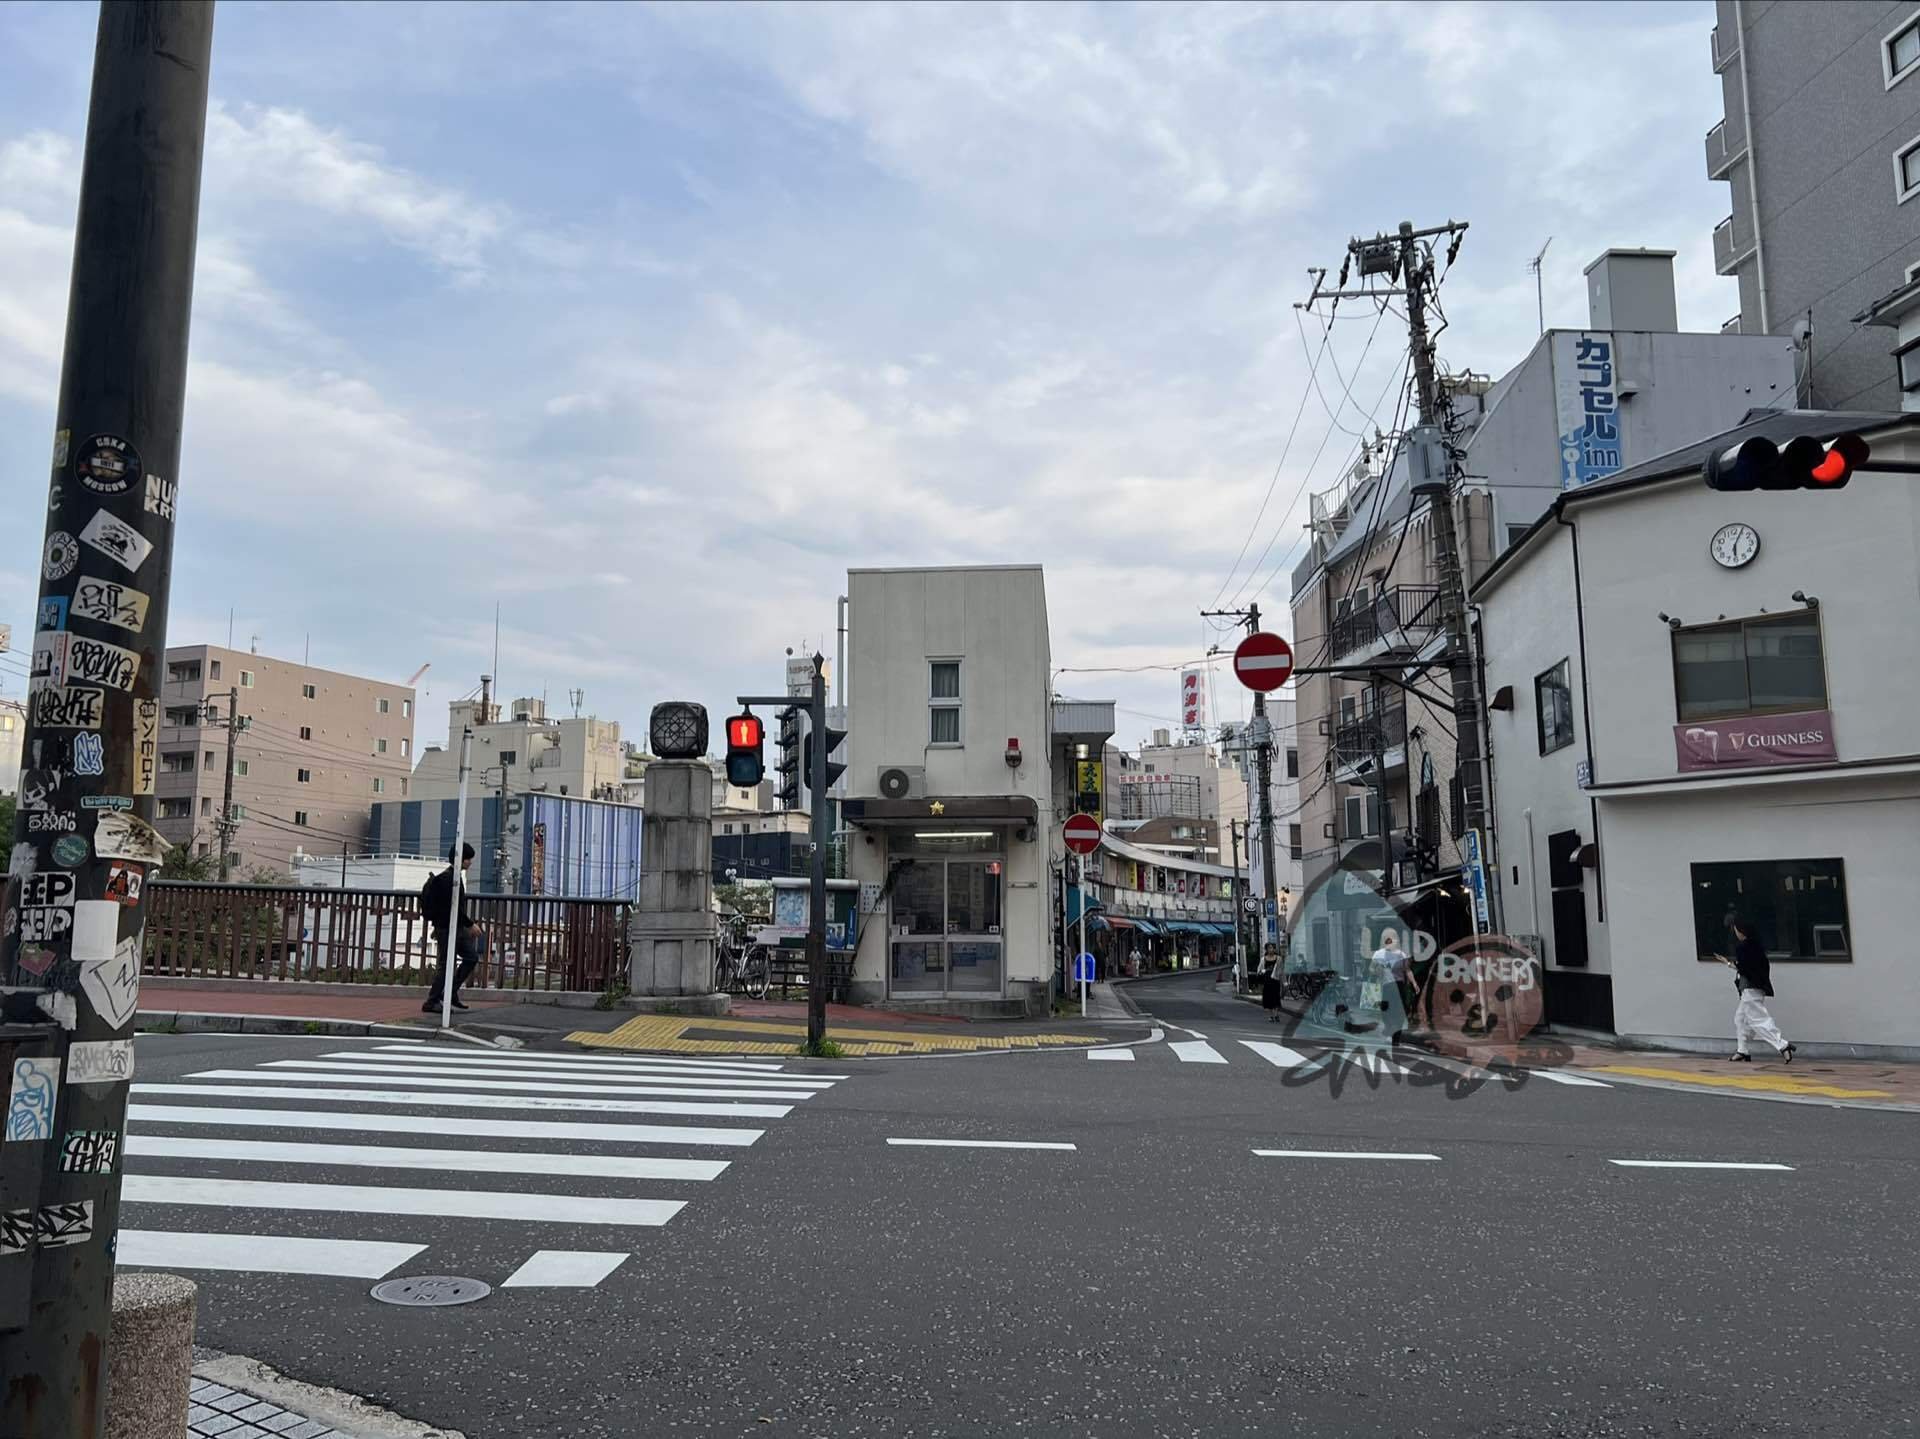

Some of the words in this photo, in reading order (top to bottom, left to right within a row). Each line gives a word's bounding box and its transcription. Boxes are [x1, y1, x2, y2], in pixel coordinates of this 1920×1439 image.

[1575, 338, 1617, 440] カプセル
[95, 437, 126, 451] CSKA
[1583, 441, 1619, 467] inn
[83, 476, 127, 492] MOSCOW
[1747, 731, 1824, 748] GUINNESS
